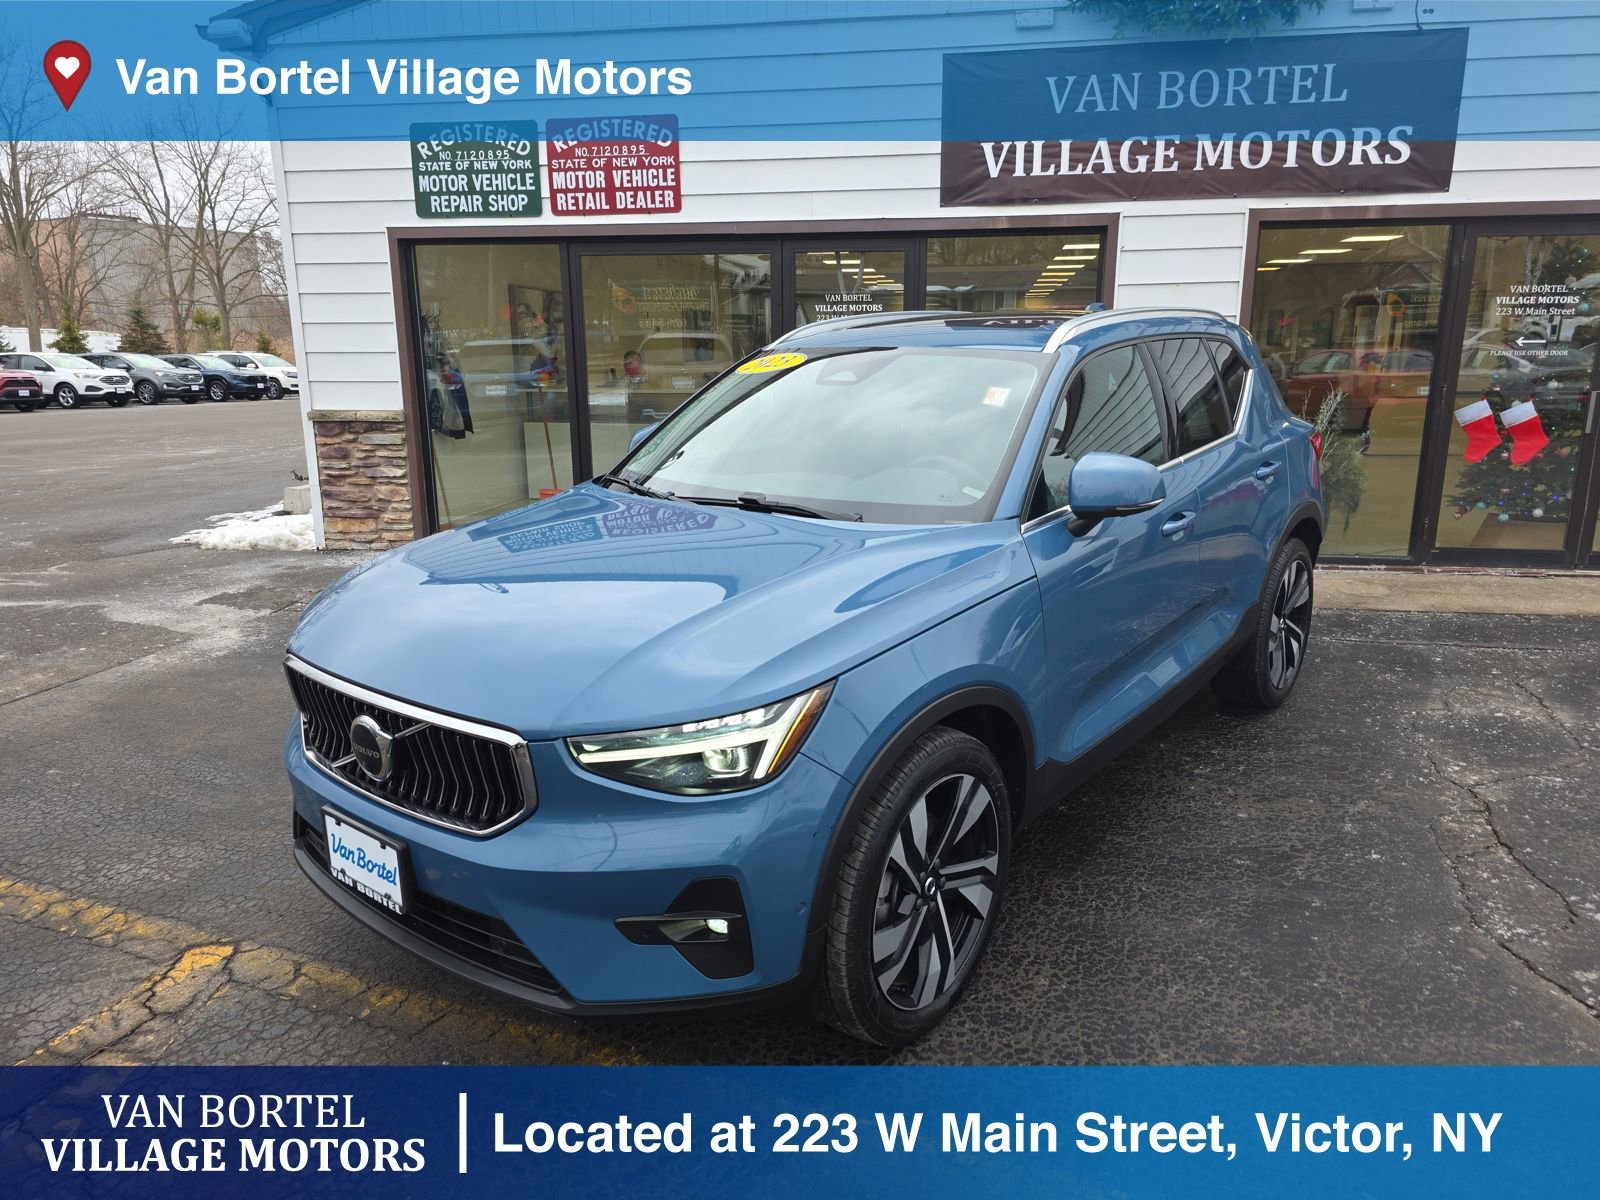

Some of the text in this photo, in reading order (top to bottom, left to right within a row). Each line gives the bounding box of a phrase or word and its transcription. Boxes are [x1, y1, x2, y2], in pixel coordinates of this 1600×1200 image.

[1046, 63, 1348, 114] VAN BORTEL
[417, 123, 531, 159] REGISTERED
[552, 119, 673, 153] REGISTERED
[439, 150, 510, 161] NO. 7120895
[575, 145, 645, 157] NO. 7120895
[980, 125, 1414, 178] VILLAGE MOTORS
[418, 160, 533, 171] STATE OF NEW YORK
[551, 155, 676, 169] STATE OF NEW YORK
[418, 172, 536, 193] MOTOR VEHICLE
[552, 168, 676, 189] MOTOR VEHICLE
[430, 194, 528, 212] REPAIR SHOP
[556, 190, 675, 210] RETAIL DEALER
[1510, 284, 1569, 293] VAN BORTEL
[825, 293, 873, 302] VAN BORTEL
[1496, 295, 1580, 305] VILLAGE MOTORS
[814, 304, 883, 312] VILLAGE MOTORS
[1495, 306, 1576, 316] 223 W Main Street
[353, 742, 380, 759] VOLVO
[331, 833, 397, 886] Van Bortel
[330, 866, 402, 915] VAN BORTEL
